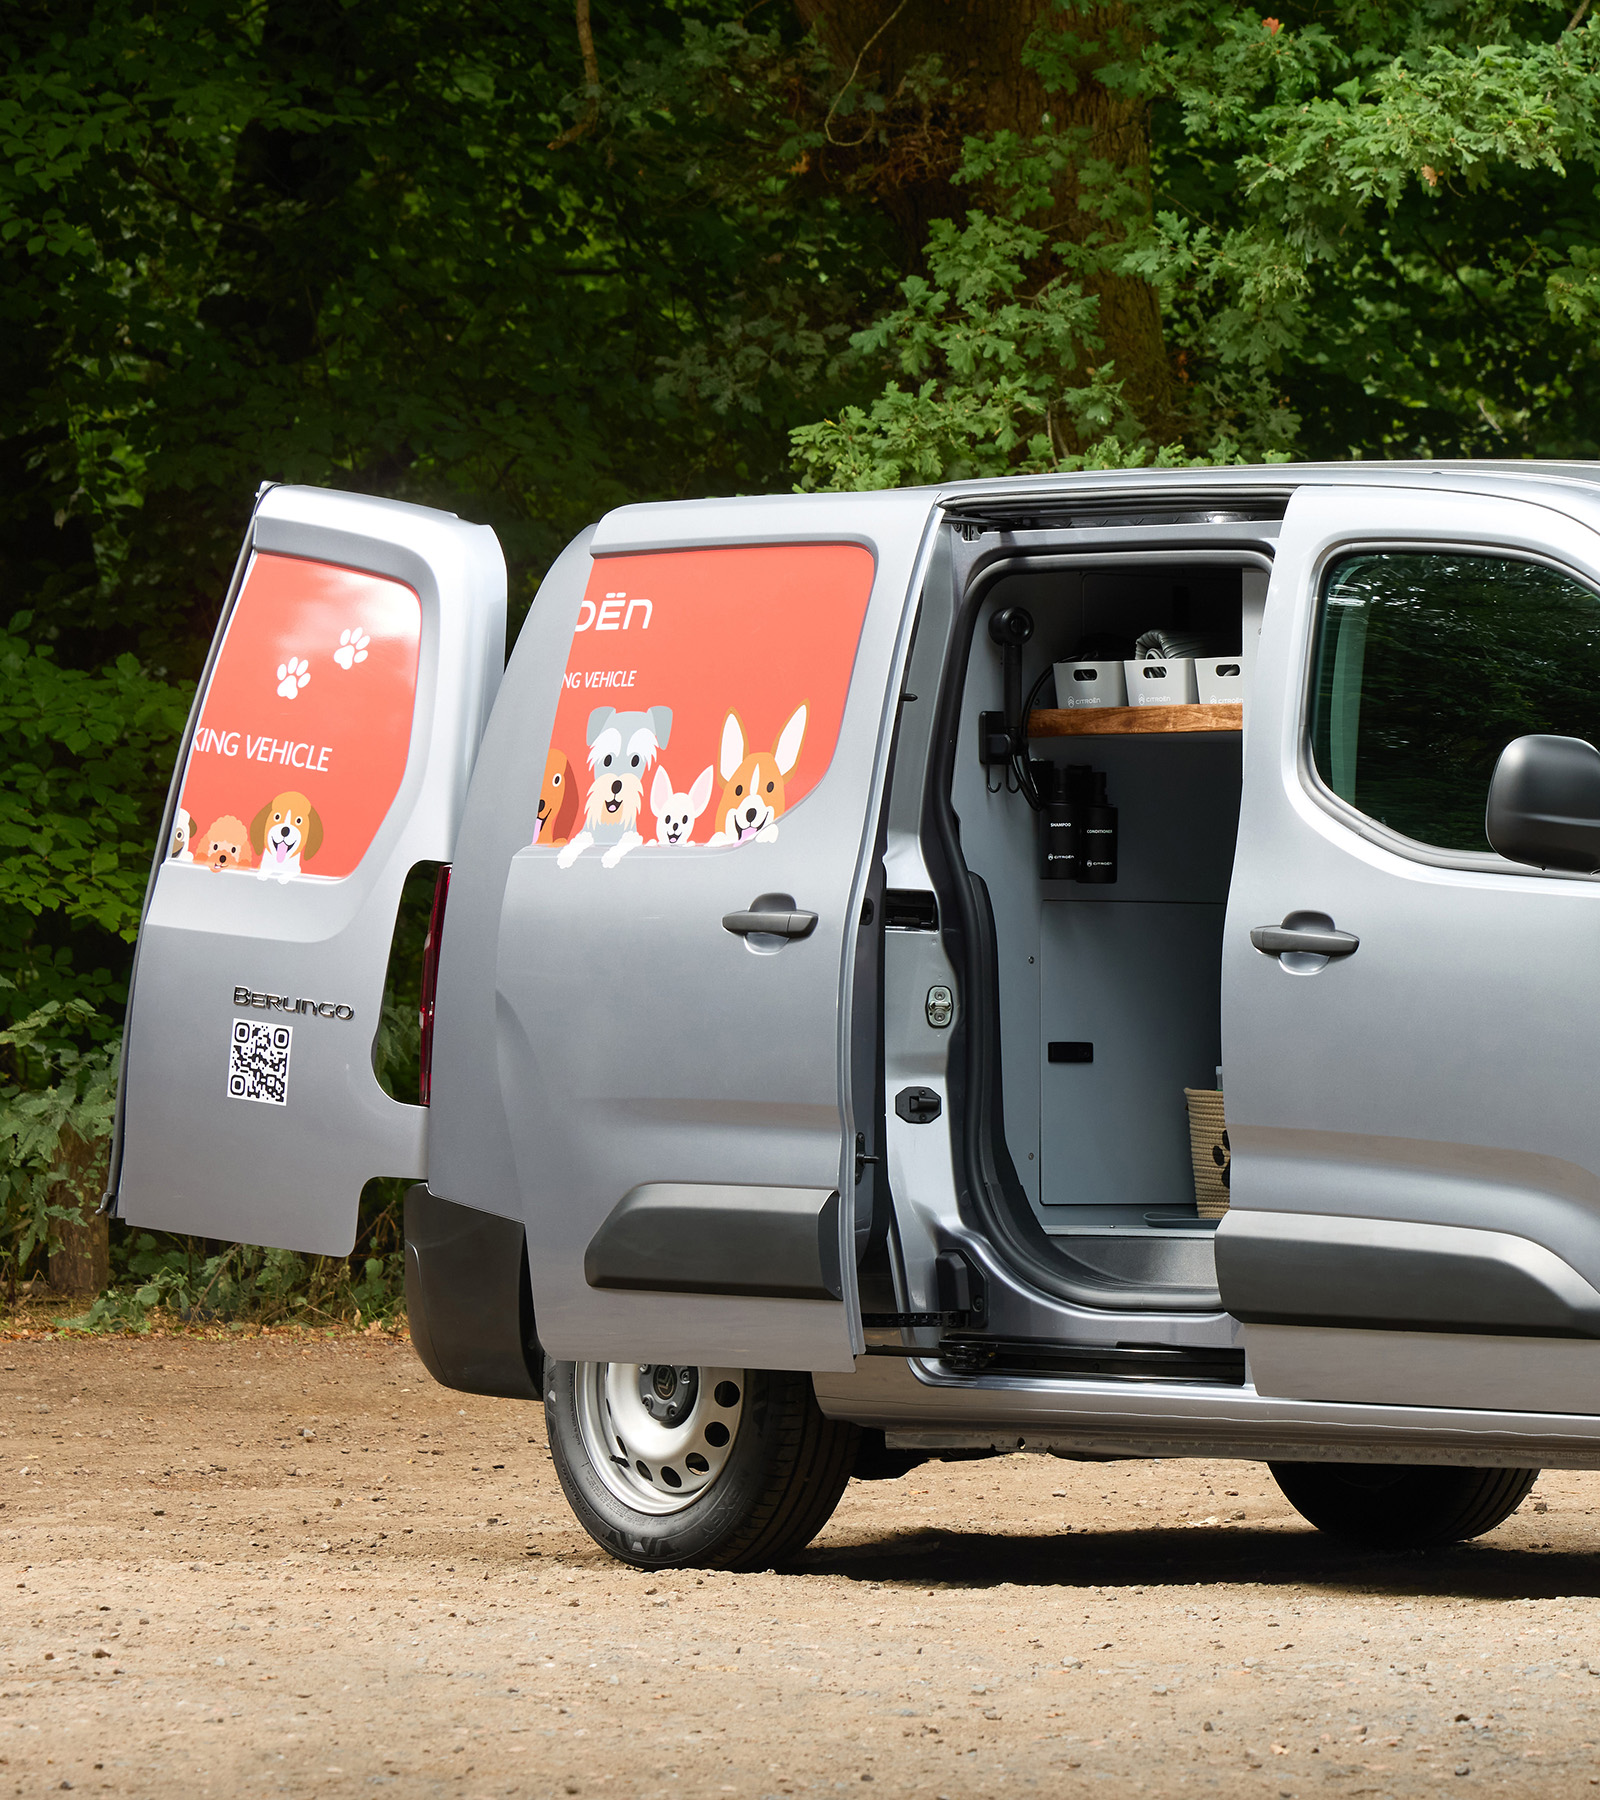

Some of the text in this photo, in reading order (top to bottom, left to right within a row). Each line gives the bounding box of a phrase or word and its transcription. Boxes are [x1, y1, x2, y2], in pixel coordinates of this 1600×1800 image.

[585, 670, 637, 688] VEHICLE
[246, 734, 333, 772] VEHICLE
[233, 985, 355, 1020] BERLINGO
